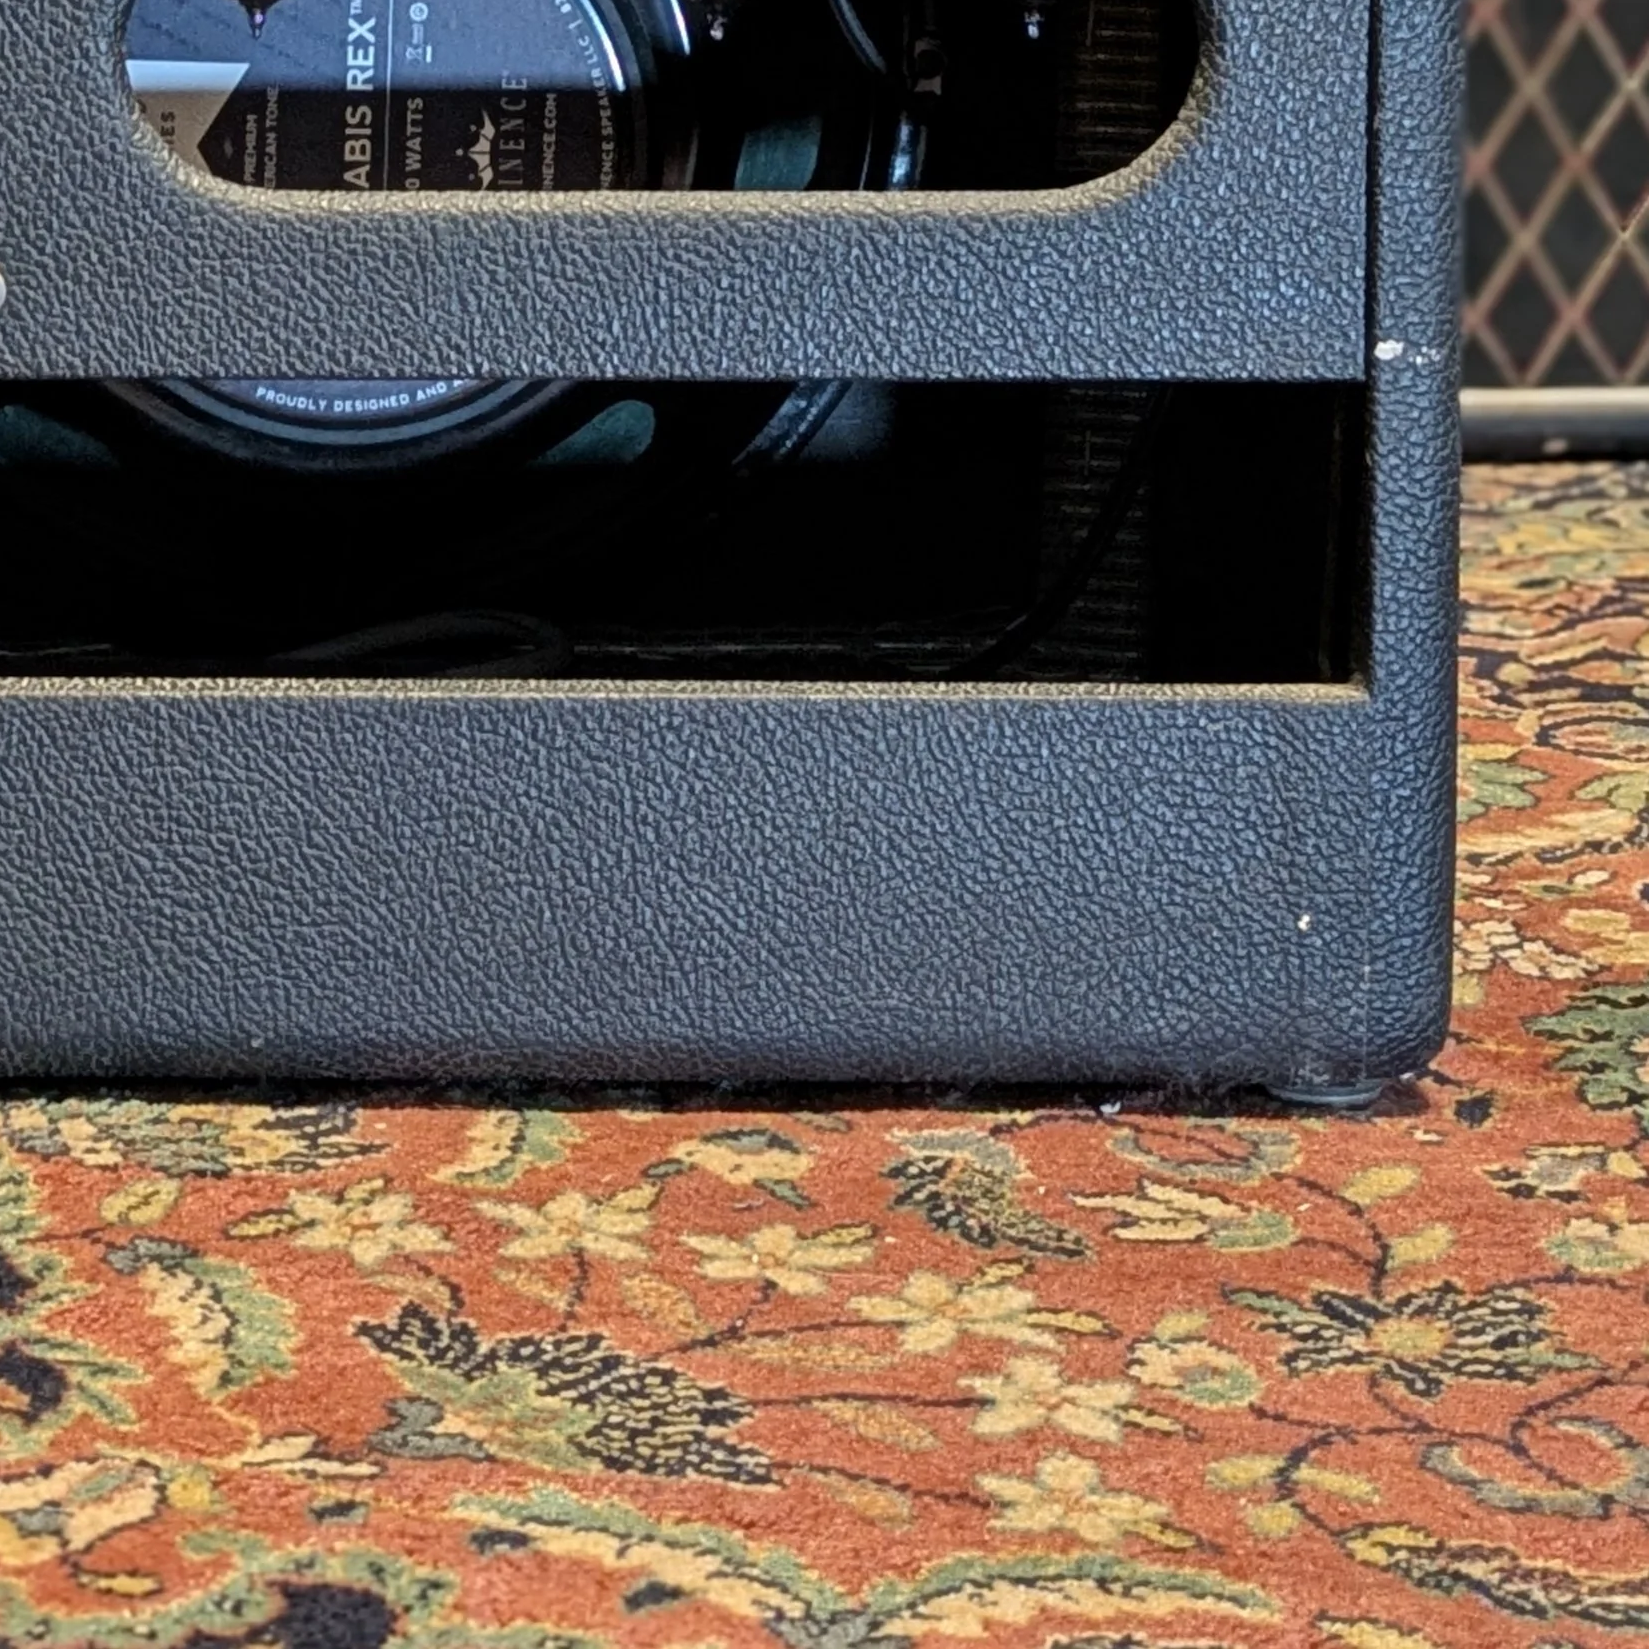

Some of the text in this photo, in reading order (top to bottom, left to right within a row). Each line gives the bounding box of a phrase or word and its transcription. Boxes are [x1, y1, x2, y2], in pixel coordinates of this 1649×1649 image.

[577, 34, 599, 71] LLC
[404, 97, 424, 172] WATTS
[497, 77, 528, 186] INENCE
[590, 66, 614, 136] SPEAKER
[263, 132, 279, 189] ERICAN
[343, 104, 373, 189] ABIS
[254, 386, 328, 412] PROUDLY
[333, 393, 411, 413] DESIGNED
[415, 381, 448, 402] AND
